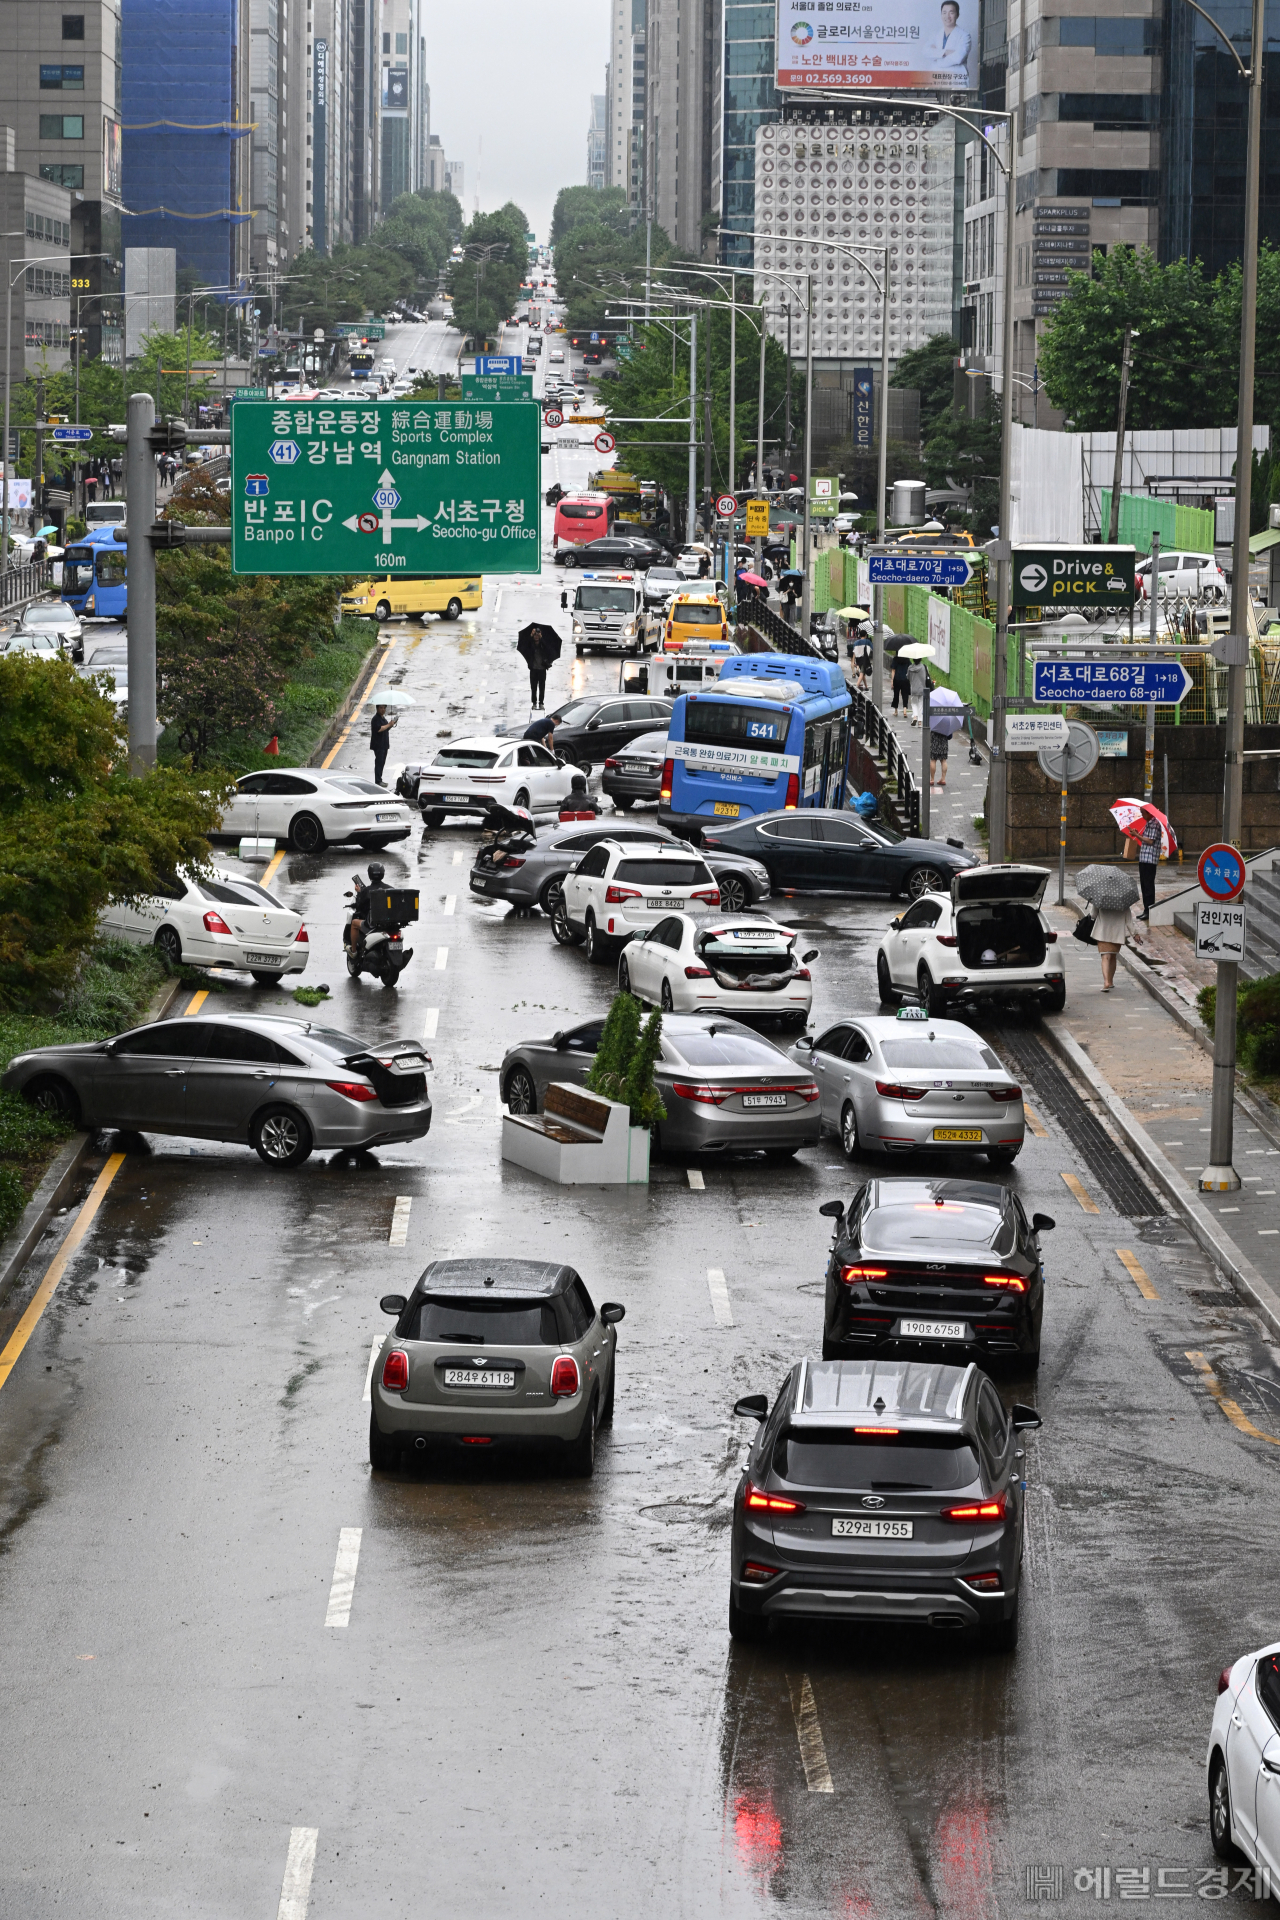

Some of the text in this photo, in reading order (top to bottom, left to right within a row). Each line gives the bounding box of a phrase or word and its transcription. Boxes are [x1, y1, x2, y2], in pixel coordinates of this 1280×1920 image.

[791, 2, 815, 11] 서울대
[818, 2, 833, 11] 졸업
[836, 2, 860, 11] 의료진
[817, 25, 920, 39] 글로리서울안과의원
[802, 54, 822, 66] 노안
[826, 54, 858, 66] 백내장
[861, 54, 882, 67] 수술
[806, 74, 872, 84] 02.569.3690
[72, 279, 90, 288] 333
[238, 389, 265, 397] 진흥아파트
[271, 410, 381, 435] 종합운동장
[391, 411, 493, 430] 綜合運動場
[549, 415, 560, 424] 50
[391, 430, 493, 445] Sports Complex
[276, 445, 292, 460] 41
[307, 440, 382, 465] 강남역
[392, 449, 501, 468] Gangnam Station
[251, 480, 260, 495] 1
[379, 491, 394, 507] 90
[434, 500, 525, 523] 서초구청
[720, 501, 733, 511] 50
[245, 527, 294, 543] Banpo
[432, 525, 536, 542] Seocho-gu Office
[374, 554, 406, 567] 160m
[872, 558, 942, 573] 서초대로70길
[872, 573, 955, 584] Seocho-daero 70-gil
[1040, 665, 1145, 684] 서초대로68길
[1039, 686, 1165, 700] Seocho-daero 68-gil
[751, 723, 774, 738] 541
[1012, 721, 1062, 731] 서초2동 주민센터
[674, 746, 697, 758] 근육통
[699, 749, 715, 760] 완화
[716, 752, 747, 763] 의료기기
[720, 774, 743, 782] 우신버스
[720, 807, 738, 815] 2317
[1205, 867, 1240, 878] 주차금지
[1200, 911, 1243, 927] 견인지역
[764, 1095, 782, 1104] 7943
[958, 1131, 979, 1139] 4332
[934, 1324, 960, 1335] 6758
[449, 1371, 510, 1384] 284우 6118
[876, 1523, 908, 1535] 1955
